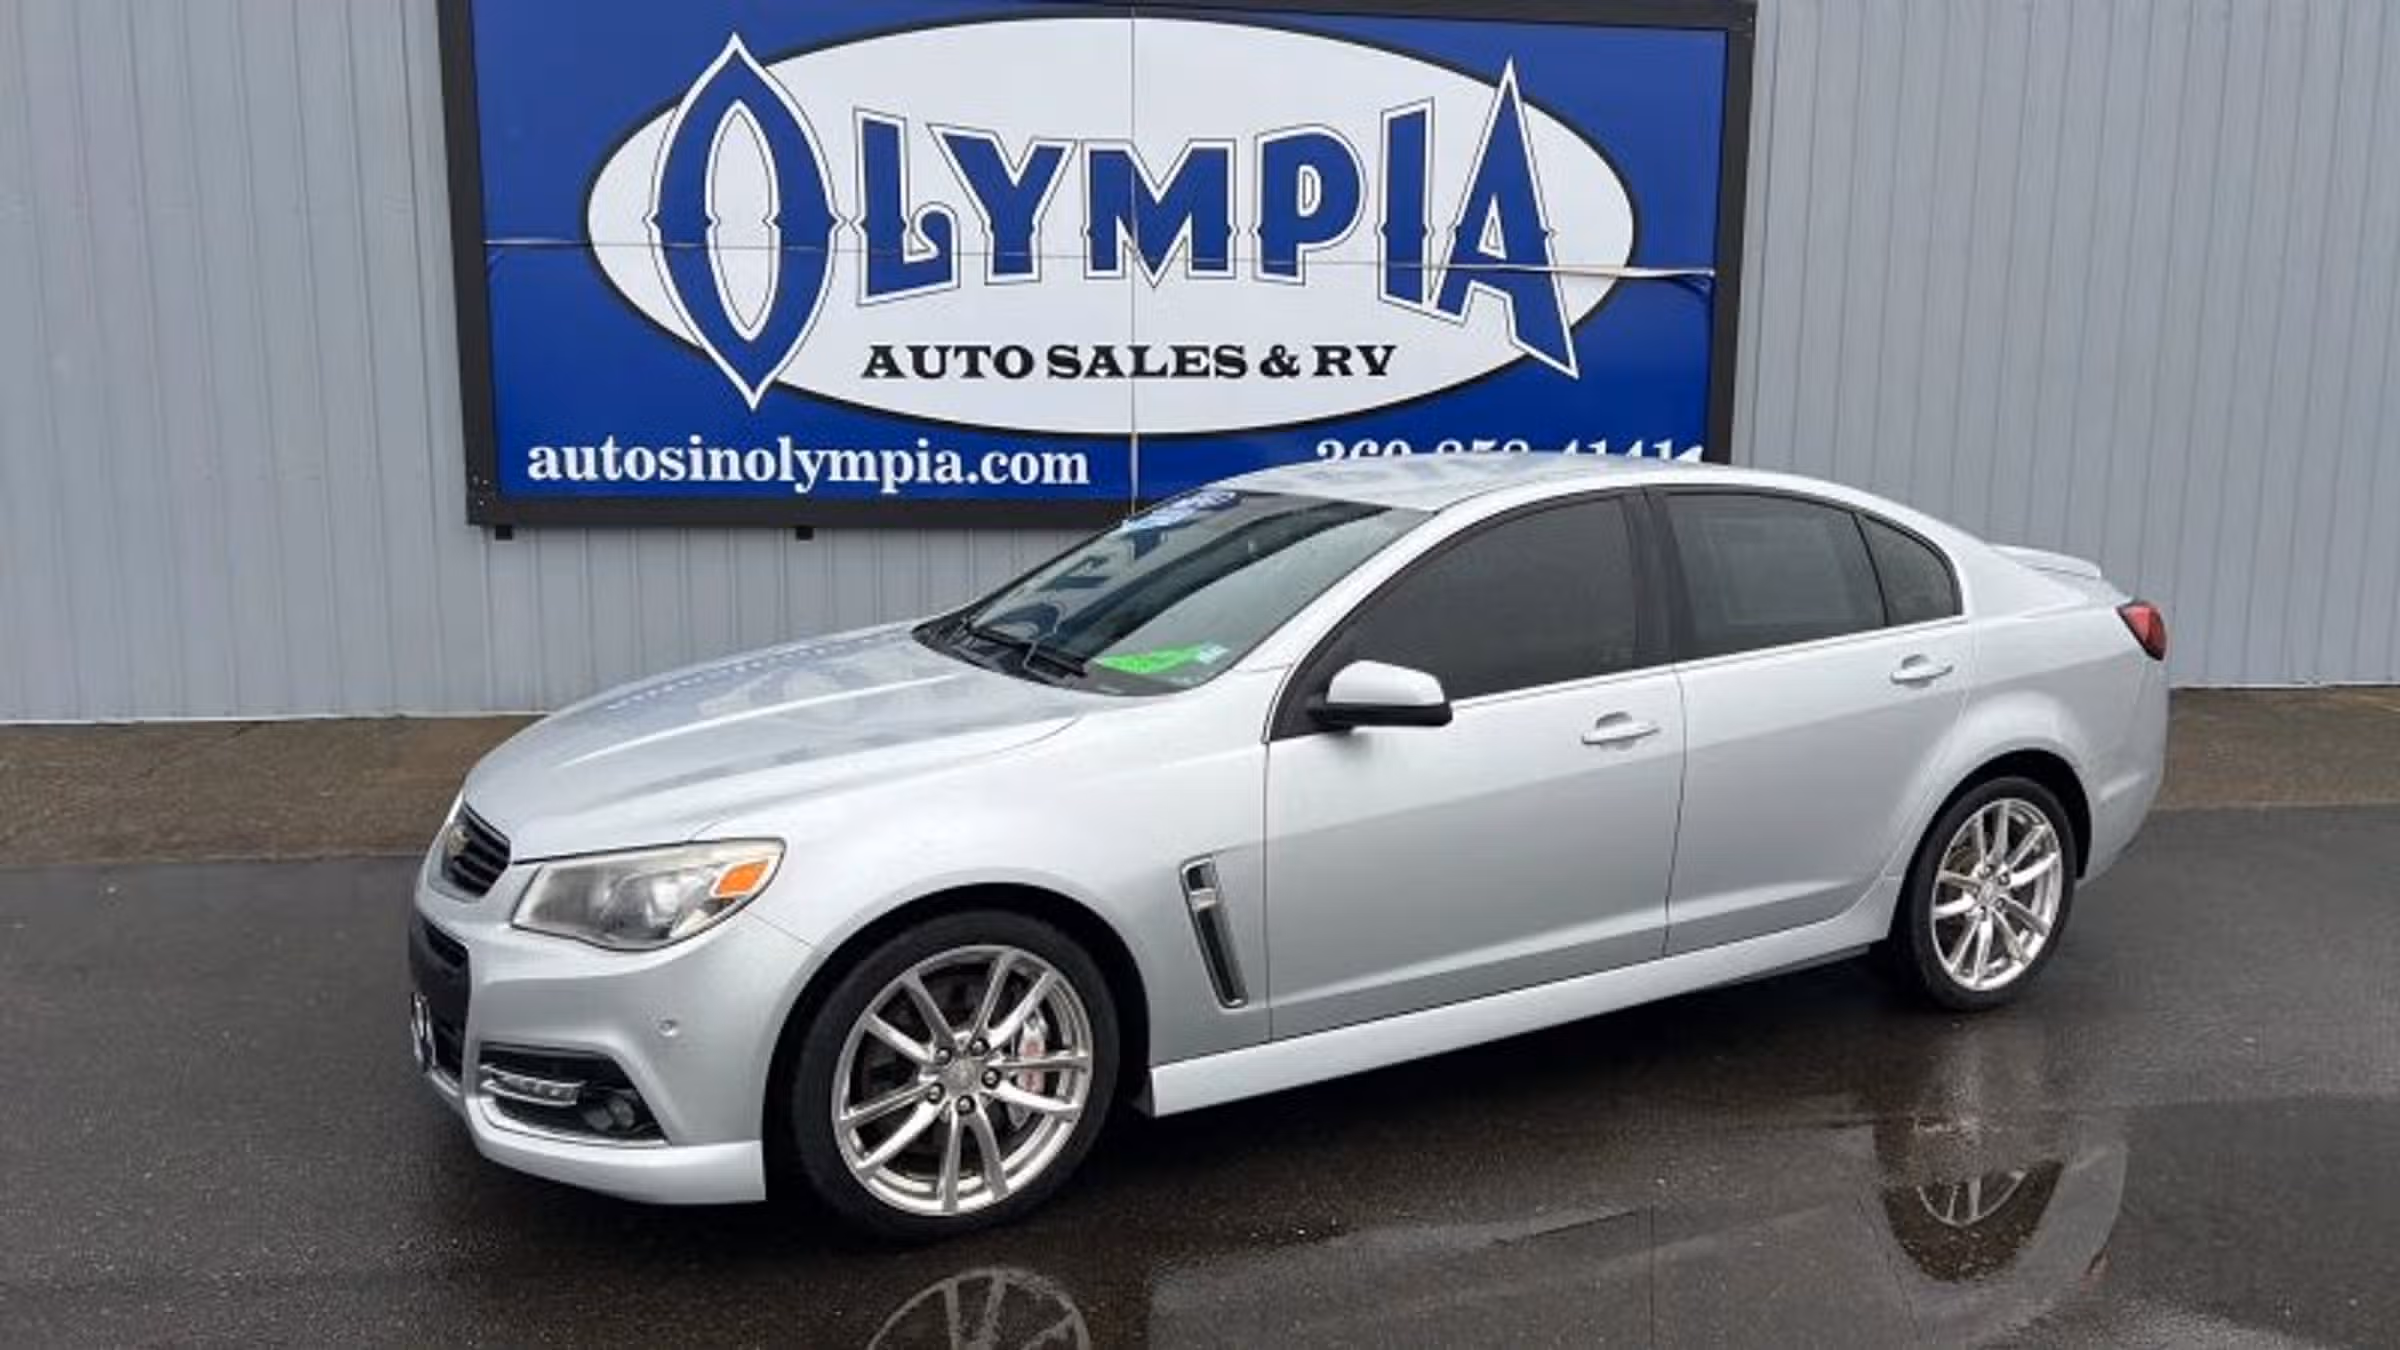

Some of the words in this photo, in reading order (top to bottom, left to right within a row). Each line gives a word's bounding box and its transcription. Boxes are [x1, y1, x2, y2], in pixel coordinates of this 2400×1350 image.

[645, 32, 1580, 411] OLYMPIA
[862, 344, 1034, 378] AUTO
[1046, 344, 1248, 378] SALES
[1259, 344, 1300, 377] &
[1313, 345, 1396, 376] RV
[526, 434, 1091, 494] autosinolympia.com
